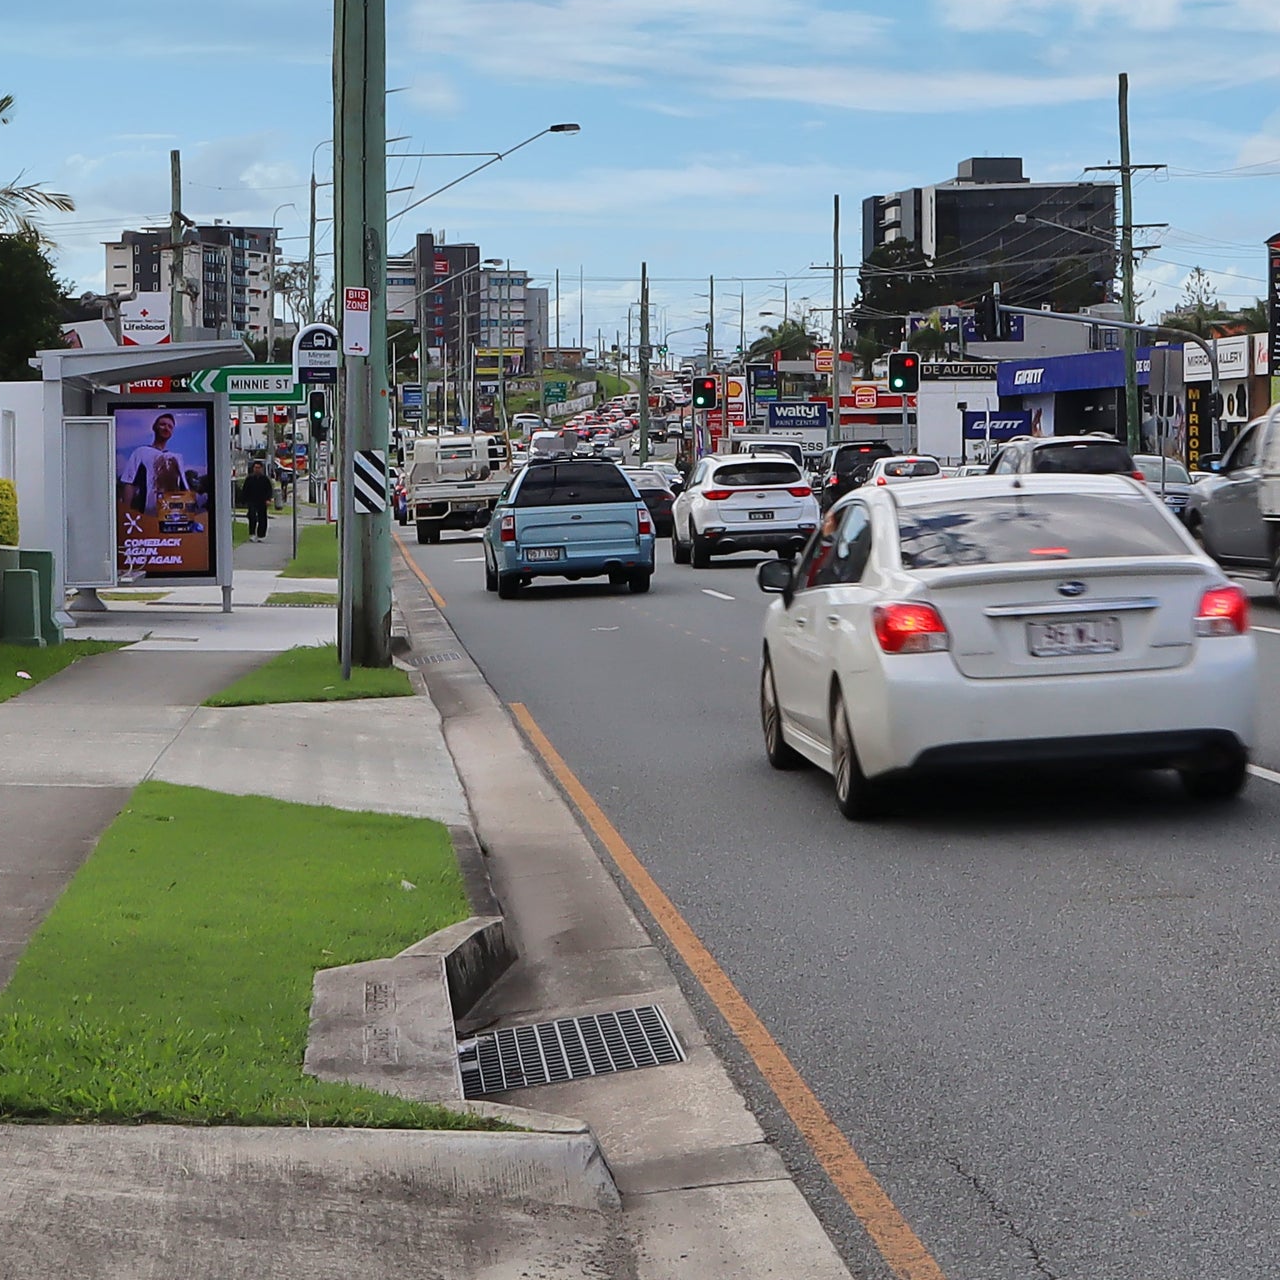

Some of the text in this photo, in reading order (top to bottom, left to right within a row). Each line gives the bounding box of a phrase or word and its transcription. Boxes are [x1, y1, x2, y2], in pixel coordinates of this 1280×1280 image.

[346, 299, 368, 311] ZONE
[123, 323, 166, 331] Lifeblood
[307, 351, 330, 359] Minnie
[1187, 354, 1210, 366] MIRRO
[1219, 351, 1243, 364] ALLERY
[1014, 368, 1045, 386] GIANT
[230, 379, 290, 390] MINNIE ST
[774, 404, 820, 419] wattyl
[1188, 388, 1200, 471] MIRRORS
[124, 538, 182, 547] COMEBACK
[124, 546, 158, 556] AGAIN.
[124, 555, 183, 565] AND AGAIN.
